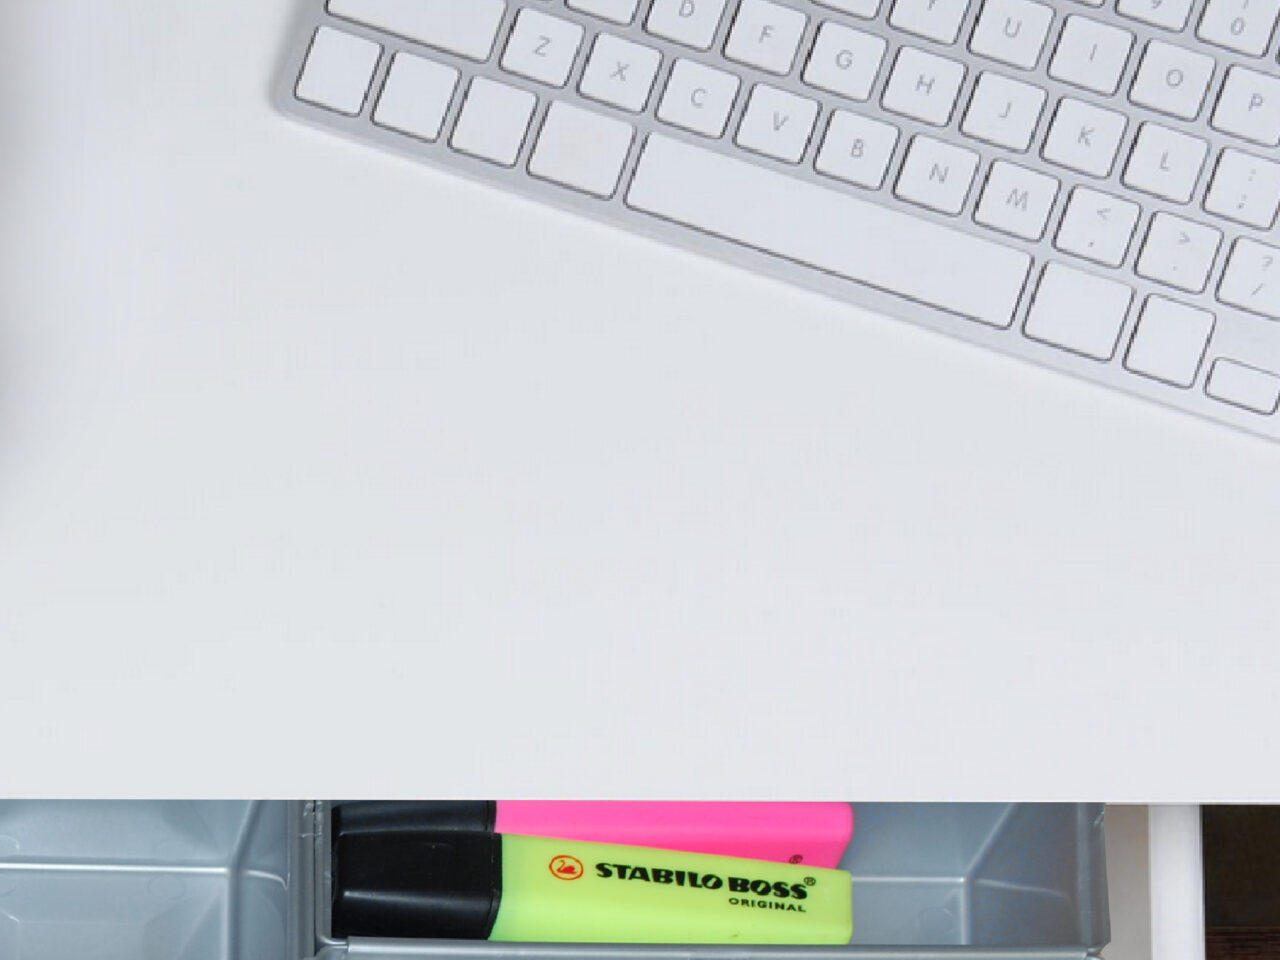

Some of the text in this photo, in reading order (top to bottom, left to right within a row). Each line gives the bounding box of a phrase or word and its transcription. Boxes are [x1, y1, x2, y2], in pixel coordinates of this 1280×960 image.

[679, 1, 695, 18] D
[758, 24, 774, 43] F
[1004, 17, 1021, 38] U
[534, 36, 552, 57] Z
[836, 49, 854, 70] G
[610, 61, 627, 82] X
[916, 74, 935, 96] H
[690, 88, 707, 108] C
[1248, 93, 1264, 112] P
[997, 101, 1013, 120] J
[773, 112, 789, 132] V
[1077, 126, 1096, 147] K
[850, 138, 865, 159] B
[1159, 151, 1170, 171] L
[929, 162, 950, 184] N
[1006, 187, 1028, 211] M
[595, 862, 723, 890] STABILO
[729, 898, 807, 913] ORIGINAL
